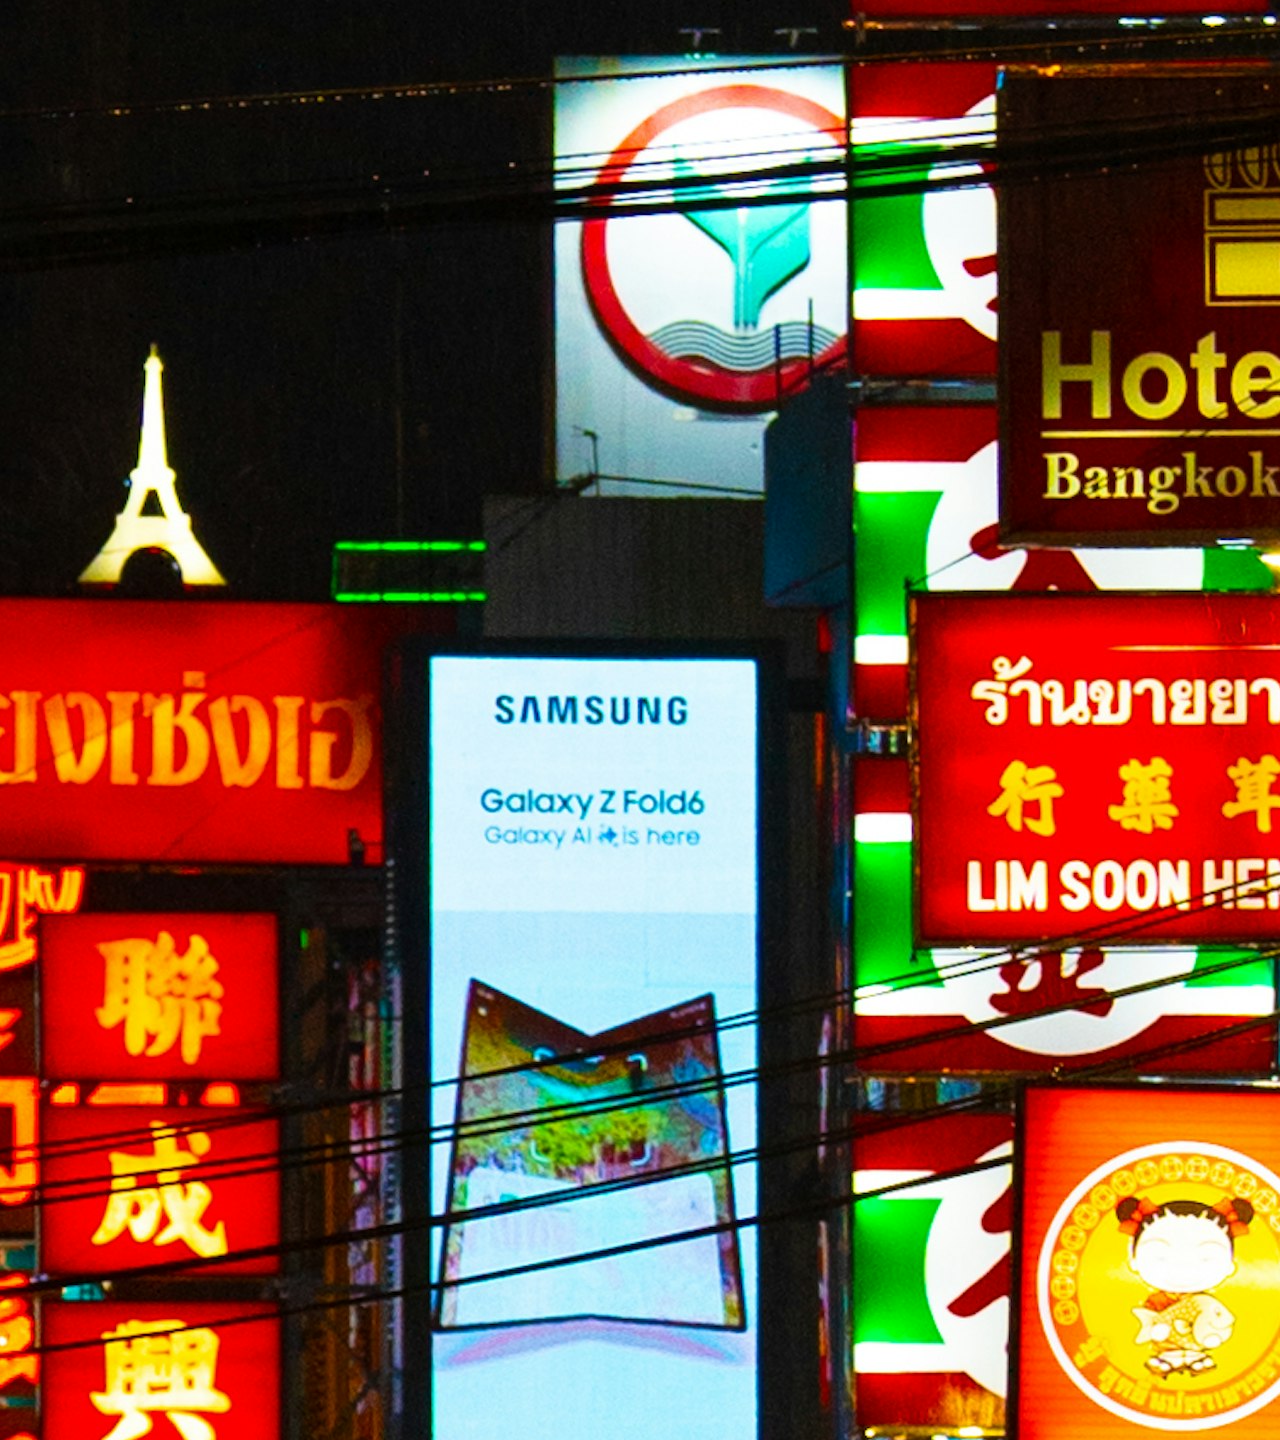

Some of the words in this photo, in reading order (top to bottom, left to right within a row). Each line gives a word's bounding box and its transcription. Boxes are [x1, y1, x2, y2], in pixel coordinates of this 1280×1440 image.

[494, 694, 689, 726] SAMSUNG
[480, 788, 595, 820] Galaxy
[599, 789, 616, 813] Z
[622, 788, 706, 816] Fold6
[484, 825, 566, 850] Galaxy
[572, 826, 593, 845] AI
[621, 826, 640, 846] is
[646, 826, 702, 847] here
[967, 860, 1048, 912] LIM
[1060, 859, 1190, 912] SOON
